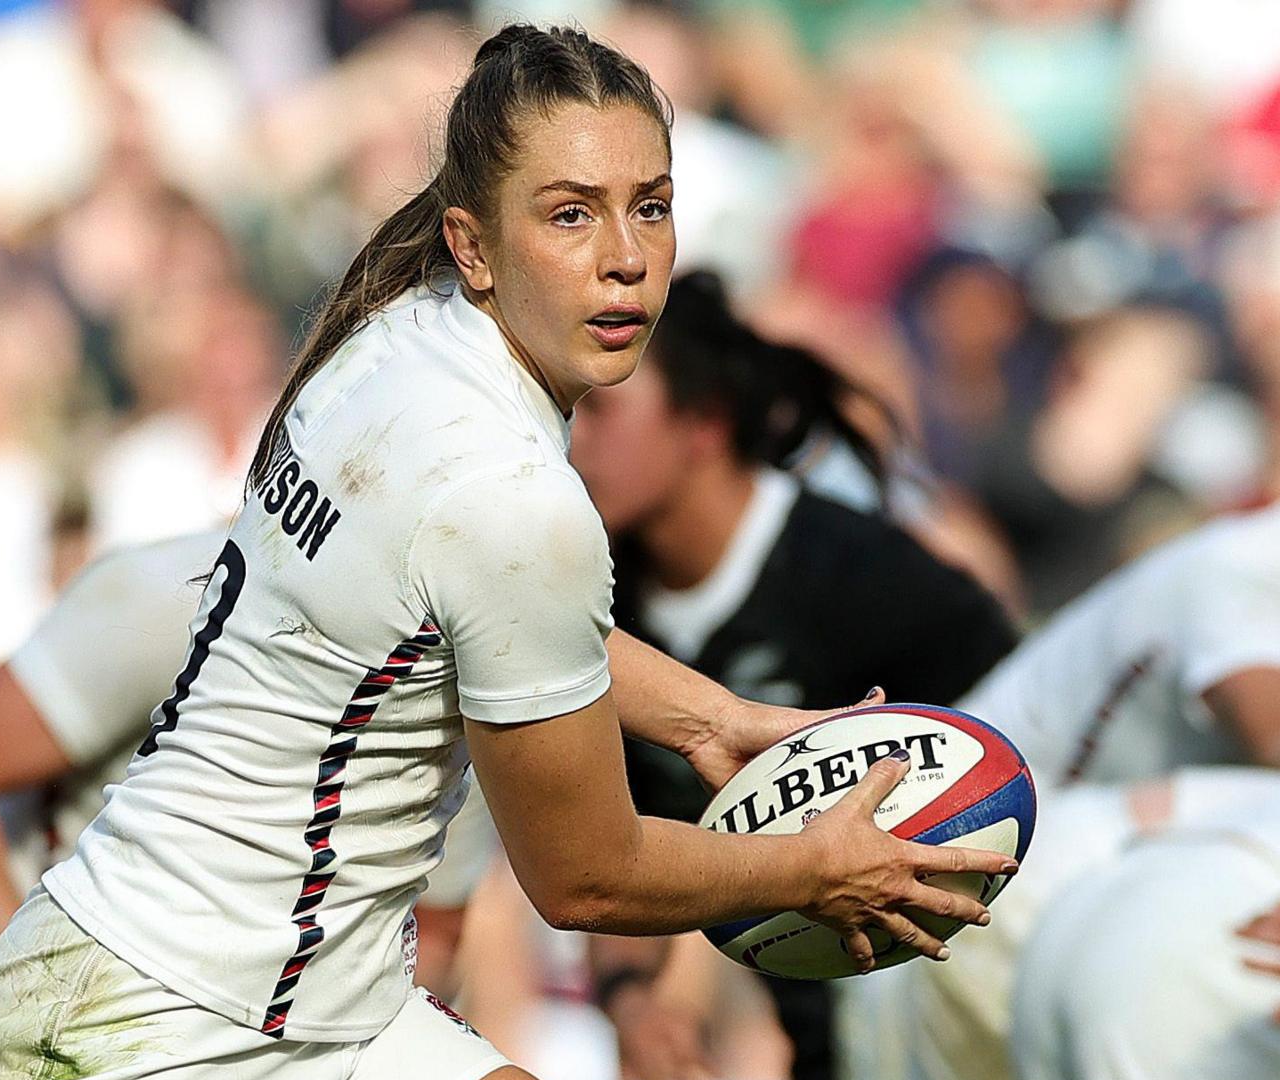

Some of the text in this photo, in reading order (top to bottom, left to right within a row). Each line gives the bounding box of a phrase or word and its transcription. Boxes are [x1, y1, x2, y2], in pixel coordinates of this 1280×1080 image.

[707, 732, 947, 834] ILBERT
[916, 774, 927, 782] 10
[928, 772, 945, 781] PSI
